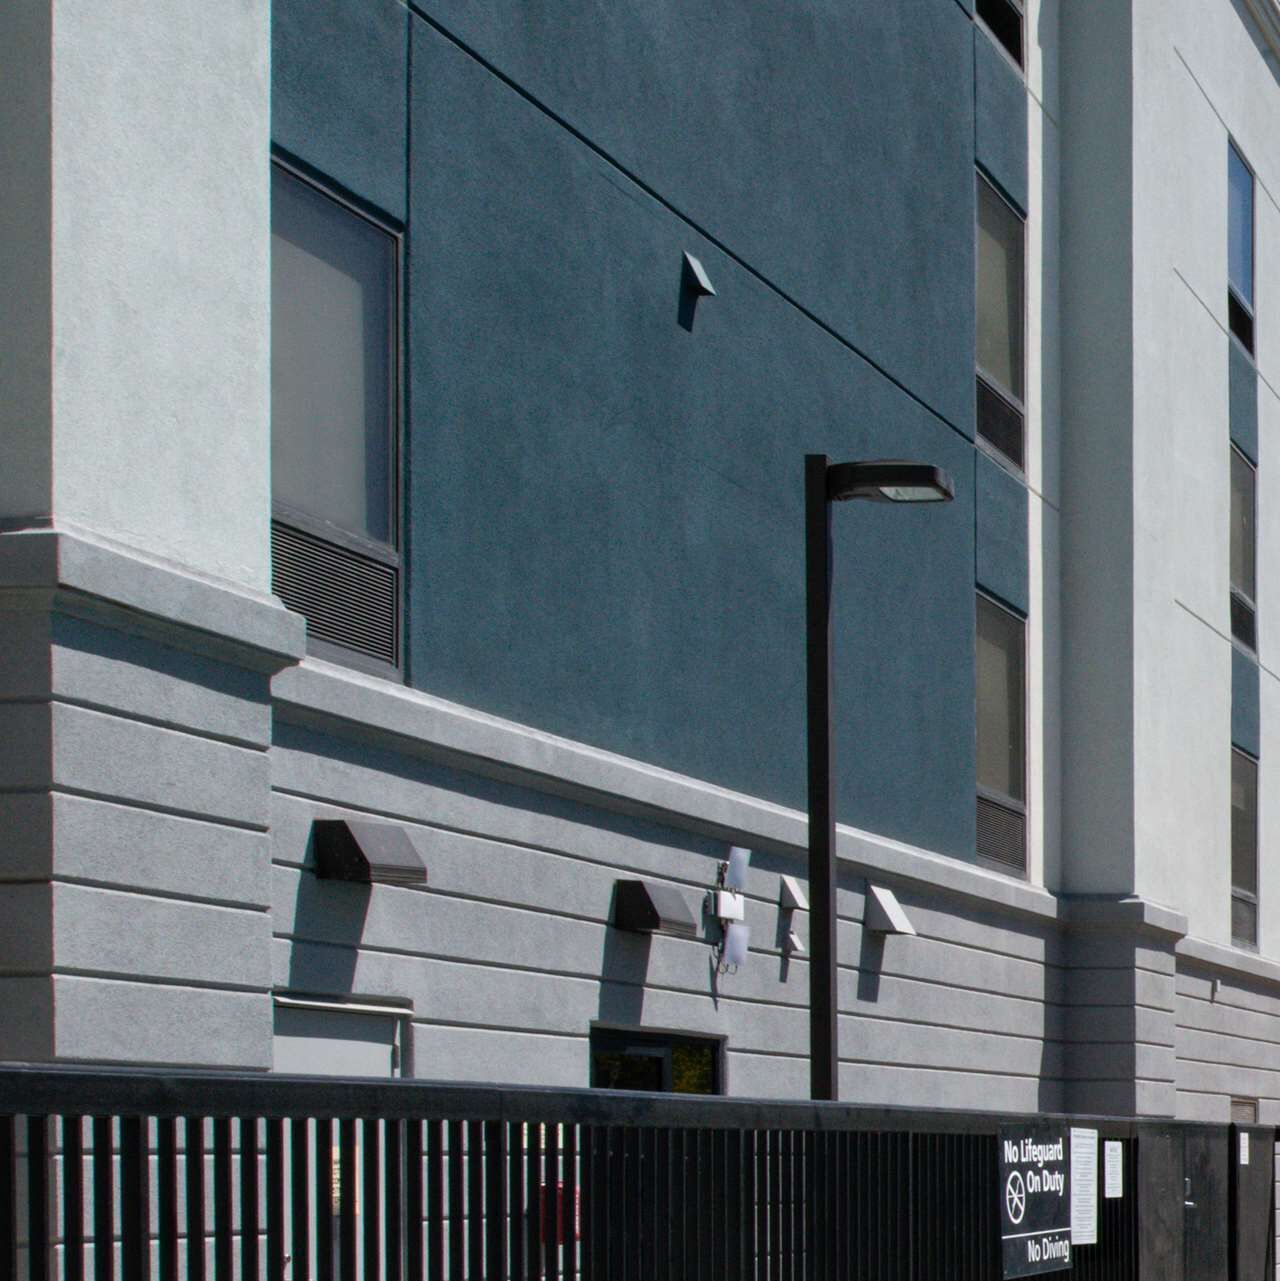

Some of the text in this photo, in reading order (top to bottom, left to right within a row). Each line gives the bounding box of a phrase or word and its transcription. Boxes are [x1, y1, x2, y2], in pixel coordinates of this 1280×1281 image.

[1004, 1137, 1063, 1168] No Lifeguard
[1026, 1169, 1065, 1197] On Duty
[1028, 1235, 1070, 1263] No Diving
